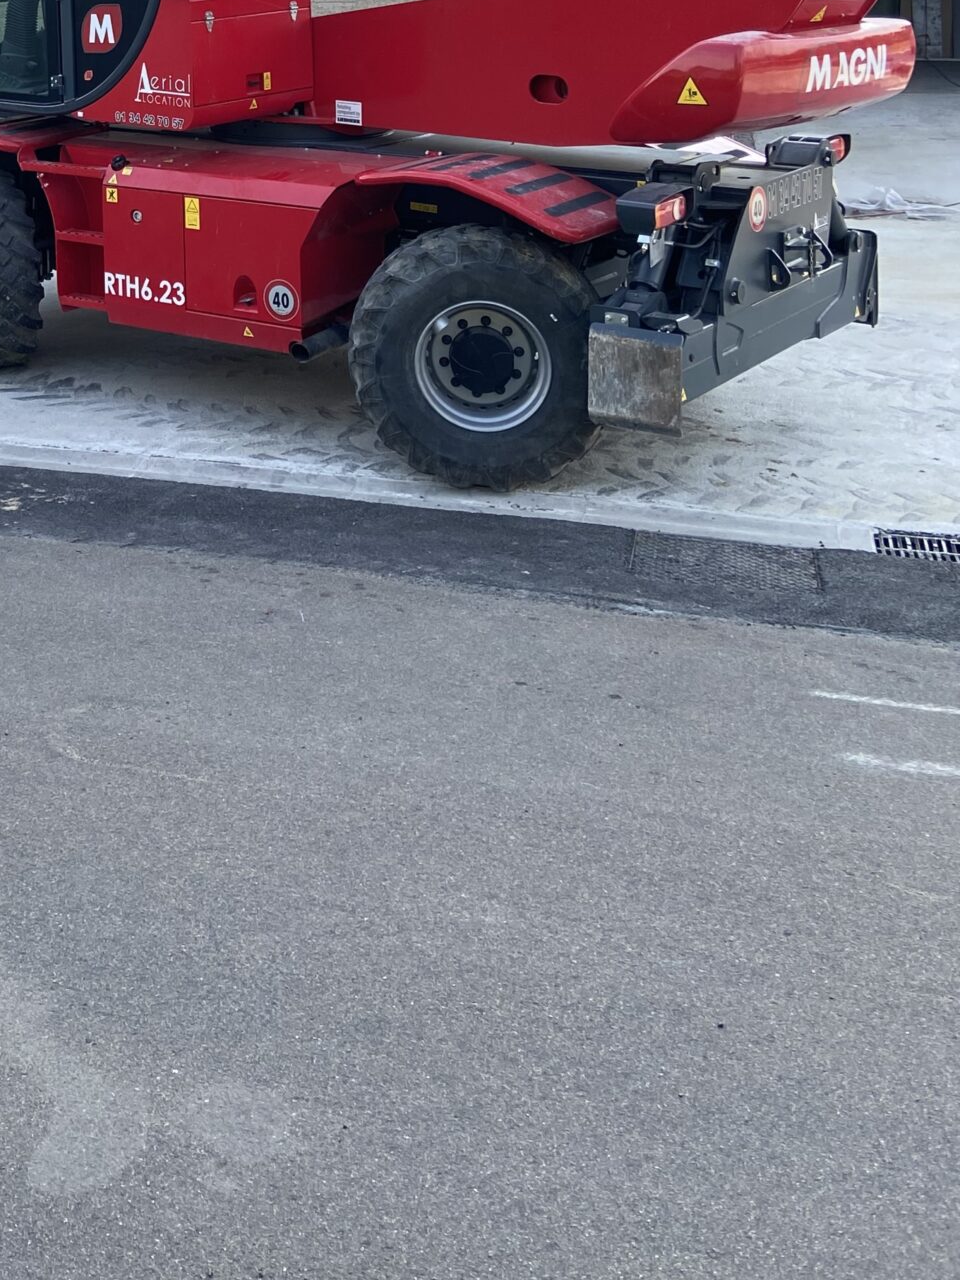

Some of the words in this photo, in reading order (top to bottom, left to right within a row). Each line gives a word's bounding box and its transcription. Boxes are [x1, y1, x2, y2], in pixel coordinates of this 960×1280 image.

[89, 13, 115, 43] M
[805, 43, 887, 93] MAGNI
[134, 62, 191, 102] Aerial
[142, 93, 191, 108] LOCATION
[115, 111, 126, 122] 01
[129, 112, 140, 123] 34
[143, 114, 155, 125] 42
[157, 116, 169, 127] 70
[172, 118, 184, 129] 57
[754, 200, 763, 218] 40
[104, 271, 186, 307] RTH6.23
[272, 291, 290, 309] 40
